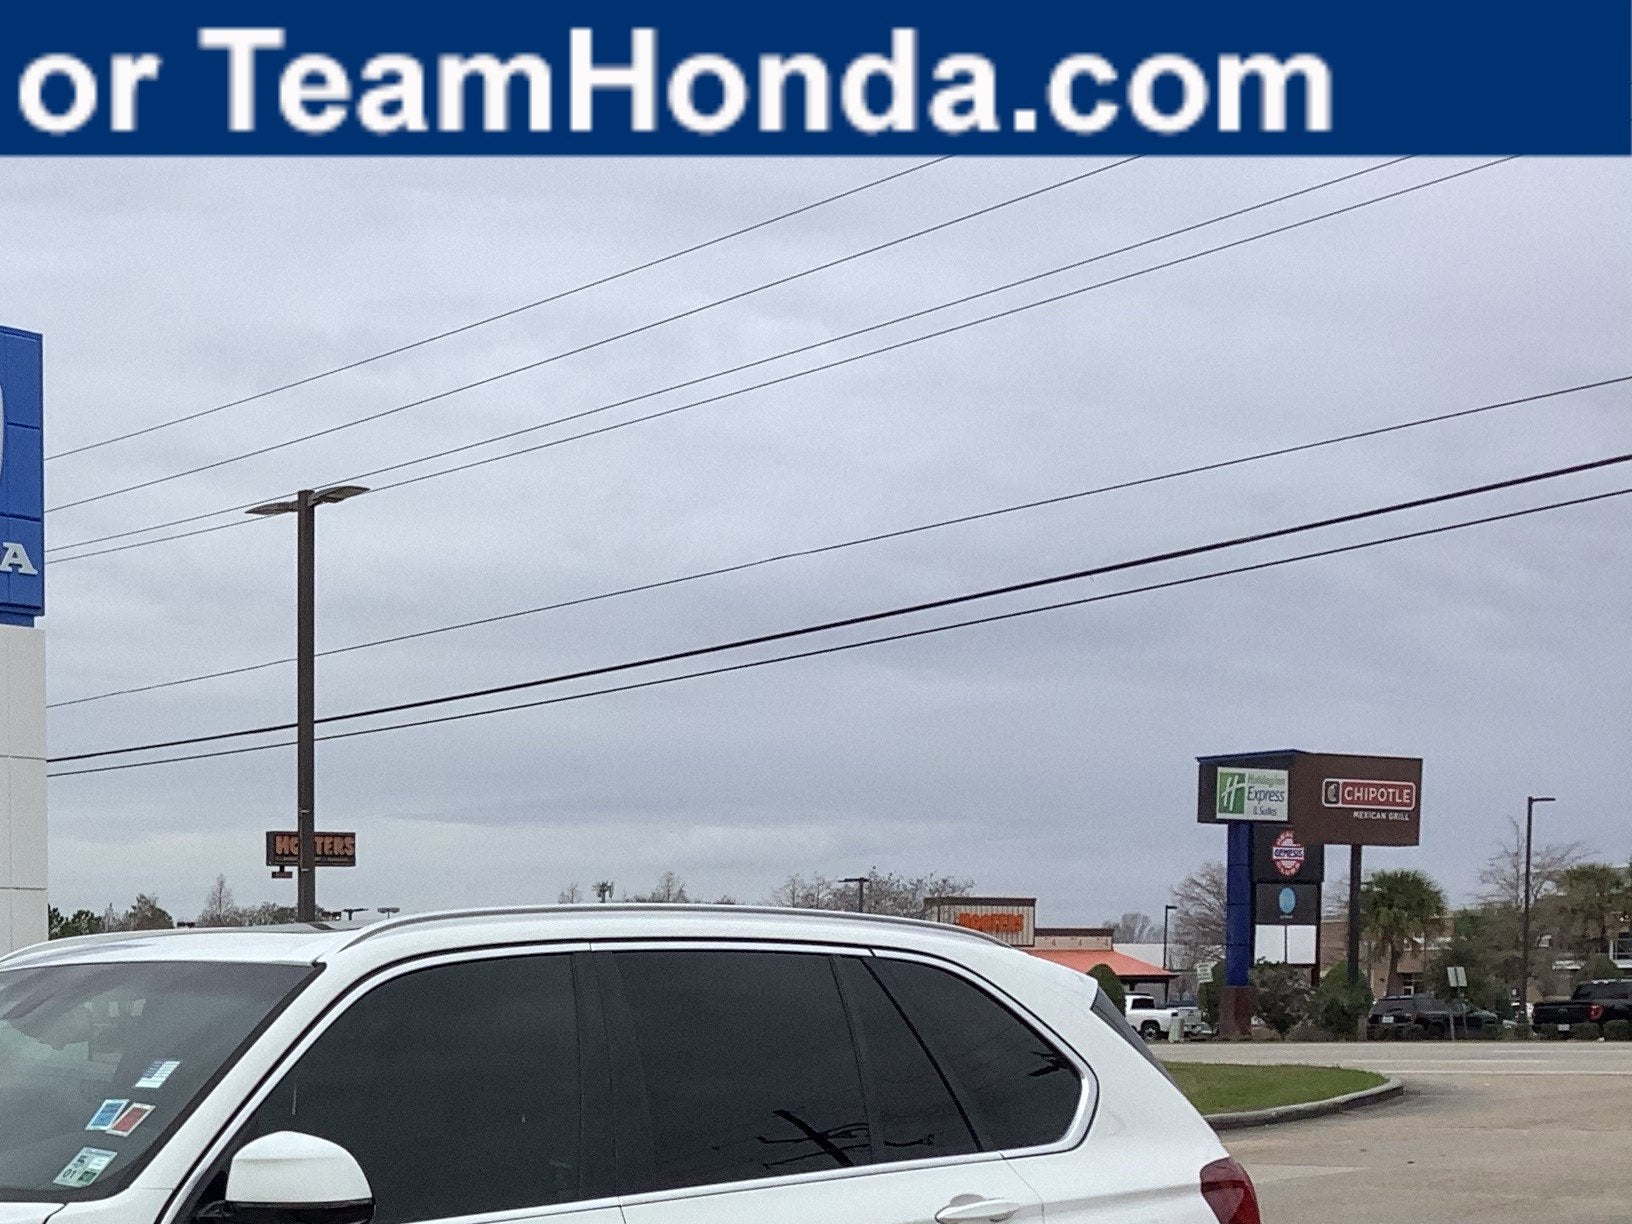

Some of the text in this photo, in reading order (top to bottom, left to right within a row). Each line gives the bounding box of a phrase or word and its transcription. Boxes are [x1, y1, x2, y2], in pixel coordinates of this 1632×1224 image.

[1248, 786, 1285, 804] Express
[1344, 786, 1411, 803] CHIPOTLE
[1353, 811, 1410, 821] MEXICAN GRILL
[275, 835, 355, 856] HOTERS
